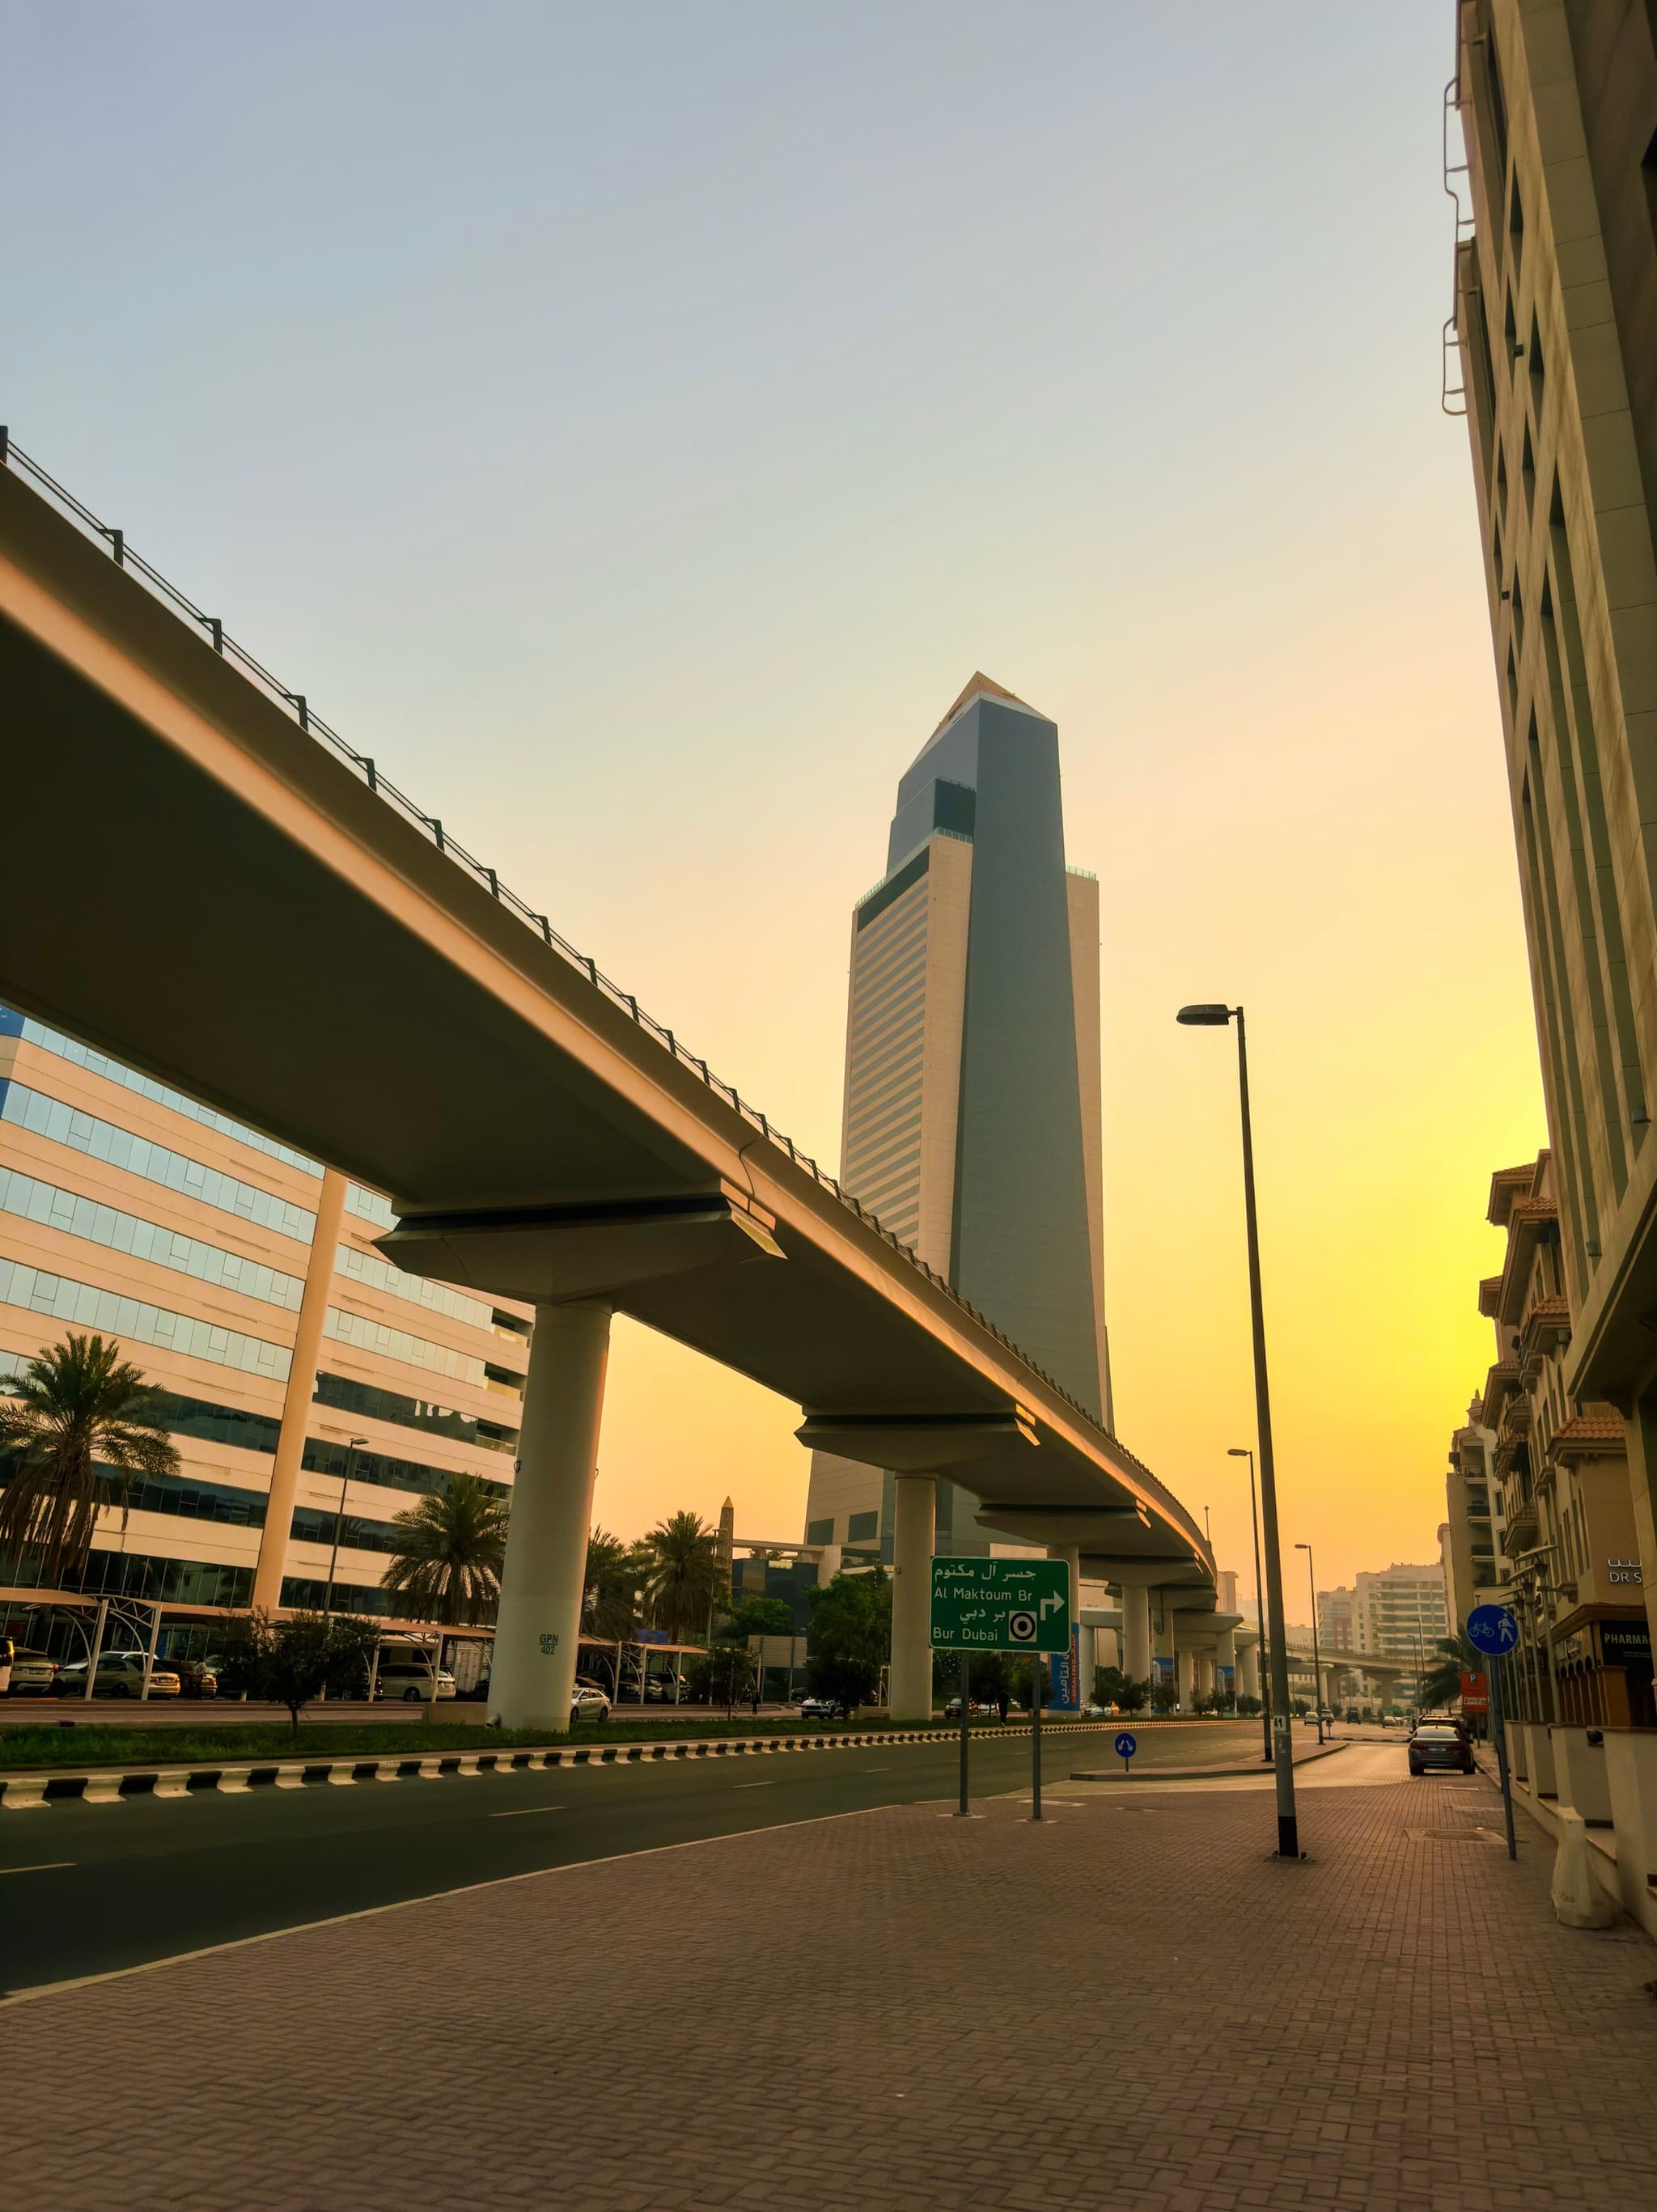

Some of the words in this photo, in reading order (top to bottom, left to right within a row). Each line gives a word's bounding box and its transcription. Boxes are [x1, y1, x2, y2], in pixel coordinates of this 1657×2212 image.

[934, 1563, 975, 1583] مكتوم
[981, 1562, 998, 1580] آل
[1002, 1570, 1036, 1582] جسر
[1609, 1572, 1629, 1583] DR
[934, 1587, 947, 1599] Al
[954, 1588, 1011, 1601] Maktoum
[1018, 1590, 1032, 1602] Br
[960, 1608, 986, 1625] دبي
[992, 1611, 1006, 1623] بر
[540, 1634, 558, 1644] GPN
[933, 1627, 955, 1639] Bur
[962, 1628, 998, 1642] Dubai
[540, 1645, 555, 1655] 402
